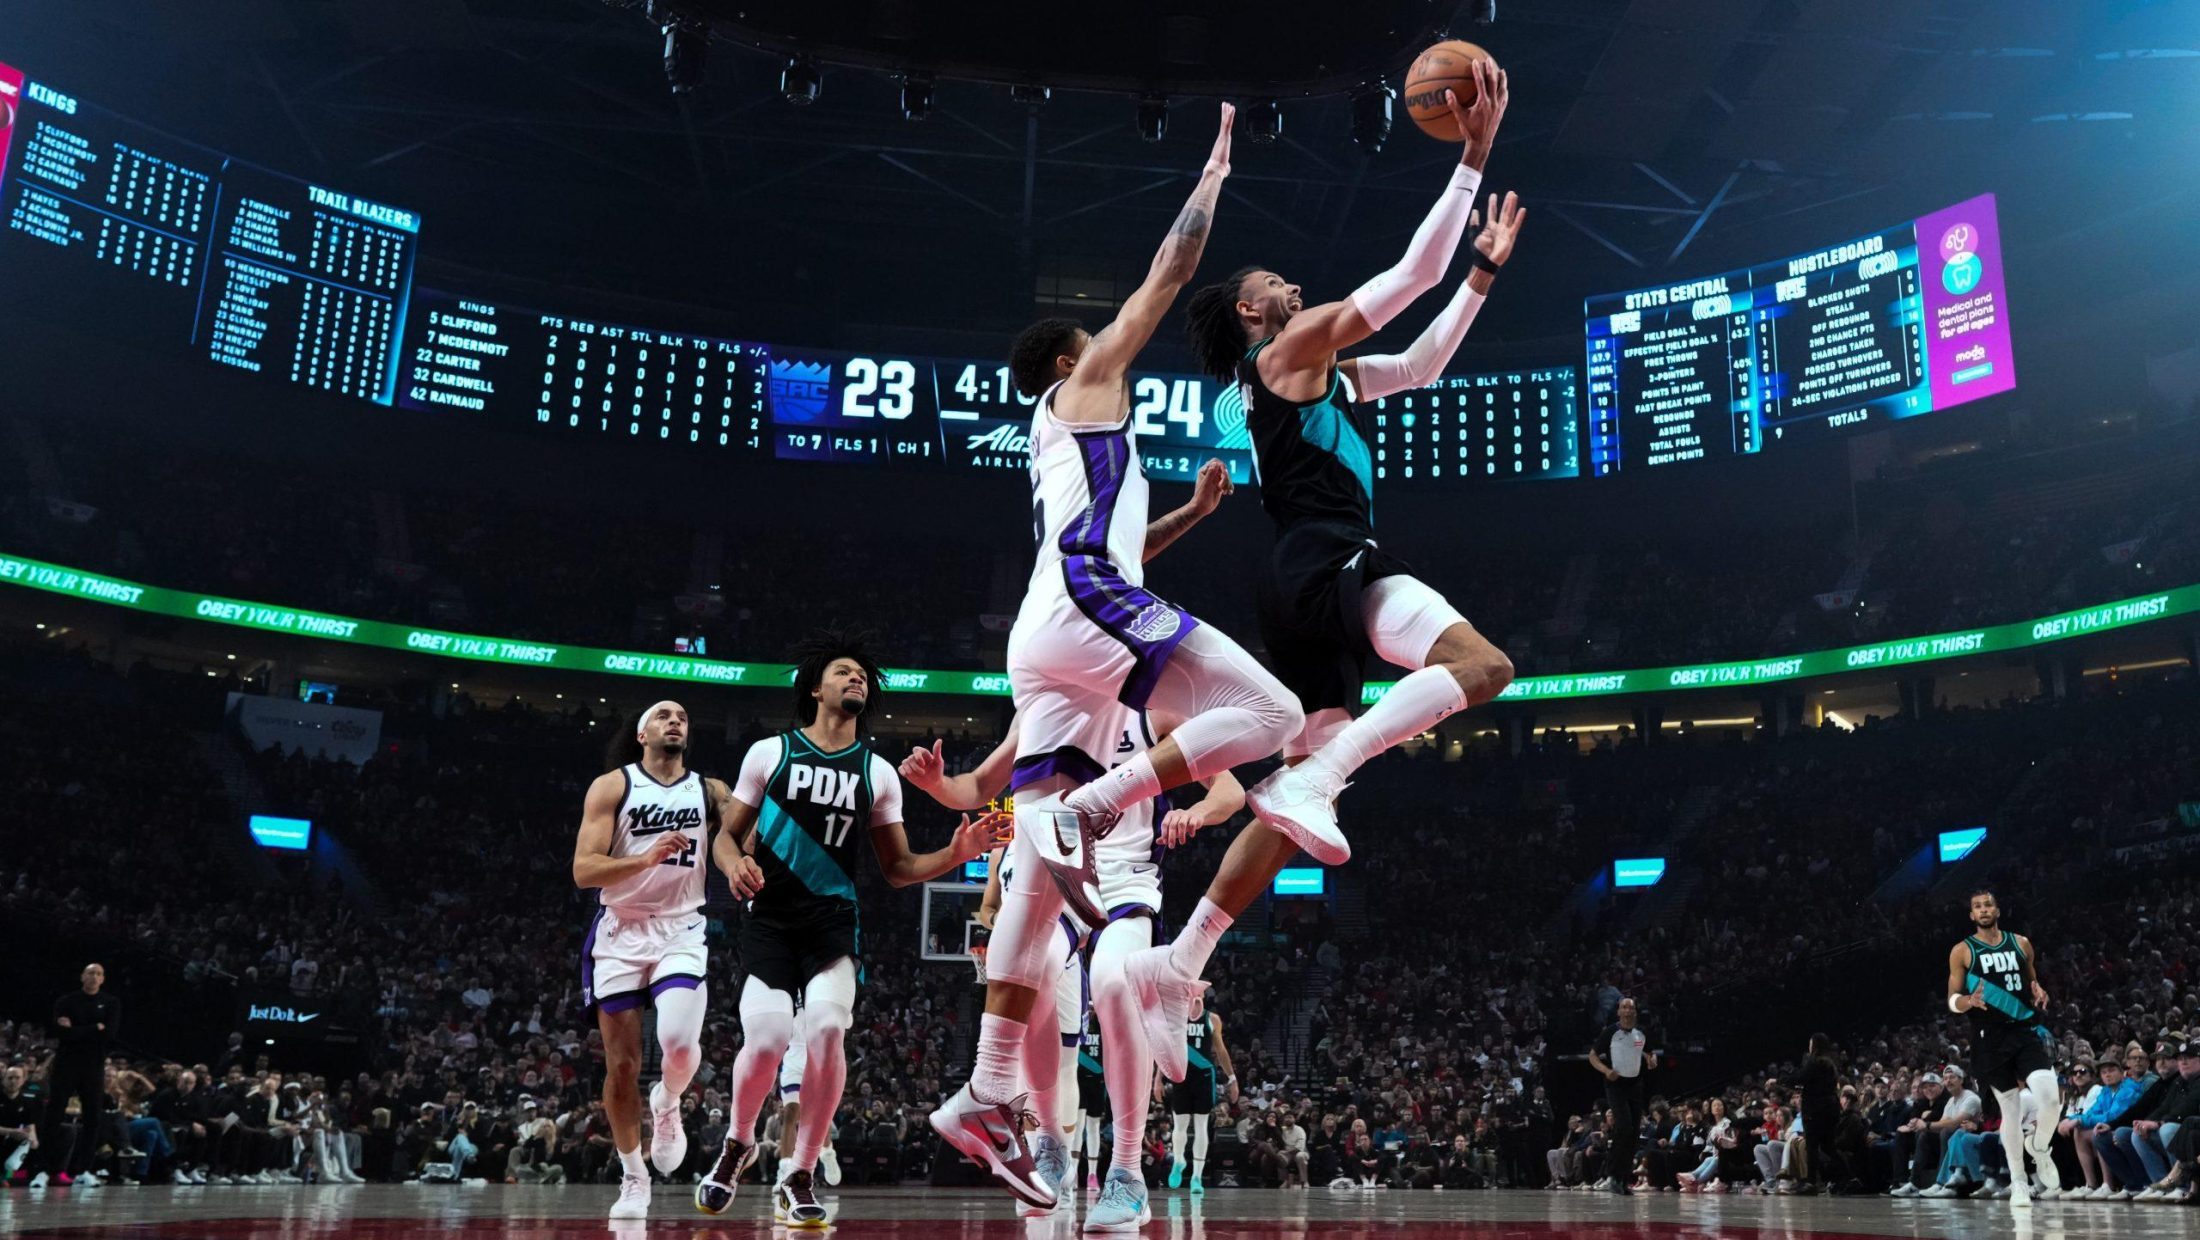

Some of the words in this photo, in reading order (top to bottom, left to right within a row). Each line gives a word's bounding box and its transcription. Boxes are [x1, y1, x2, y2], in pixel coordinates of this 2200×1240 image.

[28, 81, 78, 115] KINGS
[45, 125, 89, 149] CLIFFORD
[40, 146, 76, 166] CARTER
[42, 135, 97, 163] MCDERMOTT
[35, 166, 79, 190] RAYNAUD
[38, 156, 86, 182] CARDWELL
[31, 191, 61, 209] HAYES
[248, 199, 291, 220] THYBULLE
[309, 186, 349, 212] TRAIL
[351, 199, 413, 228] BLAZERS
[26, 212, 68, 235] BALDWIN
[28, 202, 71, 225] ACHIUWA
[246, 209, 277, 226] AVDIJA
[24, 223, 68, 247] PLOWDEN
[243, 229, 279, 248] CAMARA
[244, 219, 280, 237] SHARPE
[241, 239, 284, 260] WILLIAMS
[1788, 235, 1883, 276] HUSTLEBOARD
[236, 272, 271, 289] WESLEY
[237, 261, 290, 284] HENDERSON
[234, 282, 257, 296] LOVE
[1625, 289, 1667, 311] STATS
[1669, 276, 1729, 303] CENTRAL
[1808, 291, 1844, 309] BLOCKED
[1845, 283, 1871, 300] SHOTS
[230, 303, 254, 317] YANG
[232, 292, 269, 310] HOLIDAY
[459, 301, 496, 316] KINGS
[1825, 301, 1855, 317] STEALS
[1938, 298, 1973, 319] Medical
[1974, 292, 1992, 308] and
[228, 313, 268, 331] CLINGAN
[429, 311, 439, 324] 5
[441, 314, 498, 336] CLIFFORD
[1828, 311, 1871, 330] REBOUNDS
[1938, 308, 1968, 328] dental
[1969, 303, 1995, 323] plans
[227, 324, 263, 340] MURRAY
[541, 315, 564, 329] PTS
[570, 321, 595, 335] REB
[600, 326, 625, 339] AST
[630, 331, 653, 344] STL
[659, 335, 684, 348] BLK
[693, 338, 708, 350] TO
[718, 342, 741, 355] FLS
[1643, 330, 1667, 342] FIELD
[1668, 327, 1688, 339] GOAL
[1828, 329, 1858, 345] CHANCE
[1860, 324, 1875, 337] PTS
[1940, 328, 1955, 340] for
[1956, 323, 1970, 335] all
[1971, 315, 1995, 334] ages
[223, 344, 247, 357] KENT
[427, 330, 436, 343] 7
[438, 333, 510, 357] MCDERMOTT
[1624, 343, 1665, 359] EFFECTIVE
[1665, 341, 1688, 352] FIELD
[1689, 336, 1710, 348] GOAL
[1811, 345, 1848, 361] CHARGES
[1850, 337, 1875, 353] TAKEN
[222, 354, 261, 372] CISSOKO
[416, 348, 433, 363] 22
[435, 351, 481, 372] CARTER
[1643, 356, 1664, 369] FREE
[1666, 351, 1699, 365] THROWS
[1804, 360, 1836, 377] FORCED
[1837, 349, 1884, 370] TURNOVERS
[1955, 345, 1986, 364] moda
[413, 366, 430, 381] 32
[432, 370, 495, 394] CARDWELL
[955, 364, 1038, 406] 4:1
[1450, 378, 1471, 388] STL
[1477, 376, 1499, 387] BLK
[1507, 375, 1522, 385] TO
[1531, 372, 1552, 383] FLS
[1648, 367, 1696, 383] 3-POINTERS
[1798, 376, 1827, 391] POINTS
[1846, 361, 1892, 382] TURNOVERS
[771, 380, 830, 401] SAC
[842, 357, 916, 420] 23
[1641, 386, 1673, 400] POINTS
[1682, 381, 1705, 394] PAINT
[1822, 381, 1868, 401] VIOLATIONS
[1869, 372, 1902, 390] FORCED
[409, 387, 427, 401] 42
[430, 389, 485, 411] RAYNAUD
[1135, 376, 1205, 438] 24
[1634, 402, 1655, 414] FAST
[1656, 398, 1682, 411] BREAK
[1683, 393, 1712, 407] POINTS
[1653, 410, 1696, 425] REBOUNDS
[1828, 408, 1868, 428] TOTALS
[1658, 424, 1691, 437] ASSISTS
[788, 434, 806, 448] TO
[811, 434, 823, 450] 7
[835, 437, 863, 451] FLS
[871, 438, 878, 453] 1
[897, 441, 917, 454] CH
[923, 442, 931, 456] 1
[1649, 439, 1674, 451] TOTAL
[1675, 435, 1701, 448] FOULS
[1147, 459, 1173, 471] FLS
[1179, 459, 1190, 472] 2
[1229, 460, 1237, 474] 1
[1647, 452, 1675, 466] BENCH
[1676, 448, 1704, 462] POINTS
[28, 565, 77, 592] YOUR
[197, 599, 247, 620] OBEY
[247, 606, 297, 628] YOUR
[2032, 620, 2071, 641] OBEY
[2072, 607, 2114, 632] YOUR
[407, 631, 453, 652] OBEY
[452, 637, 498, 657] YOUR
[1847, 648, 1887, 667] OBEY
[1887, 640, 1929, 663] YOUR
[604, 653, 649, 671] OBEY
[648, 657, 689, 675] YOUR
[972, 676, 1010, 691] OBEY
[1670, 668, 1710, 687] OBEY
[1709, 665, 1752, 684] YOUR
[1535, 680, 1575, 695] YOUR
[786, 763, 861, 812] PDX
[626, 802, 702, 837] Kings
[823, 812, 856, 848] 17
[660, 839, 698, 869] 2
[1979, 950, 2020, 975] PDX
[2004, 973, 2022, 992] 33
[248, 1004, 269, 1021] Just
[270, 1006, 286, 1021] Do
[1086, 1034, 1100, 1046] DX
[1089, 1046, 1099, 1056] 35
